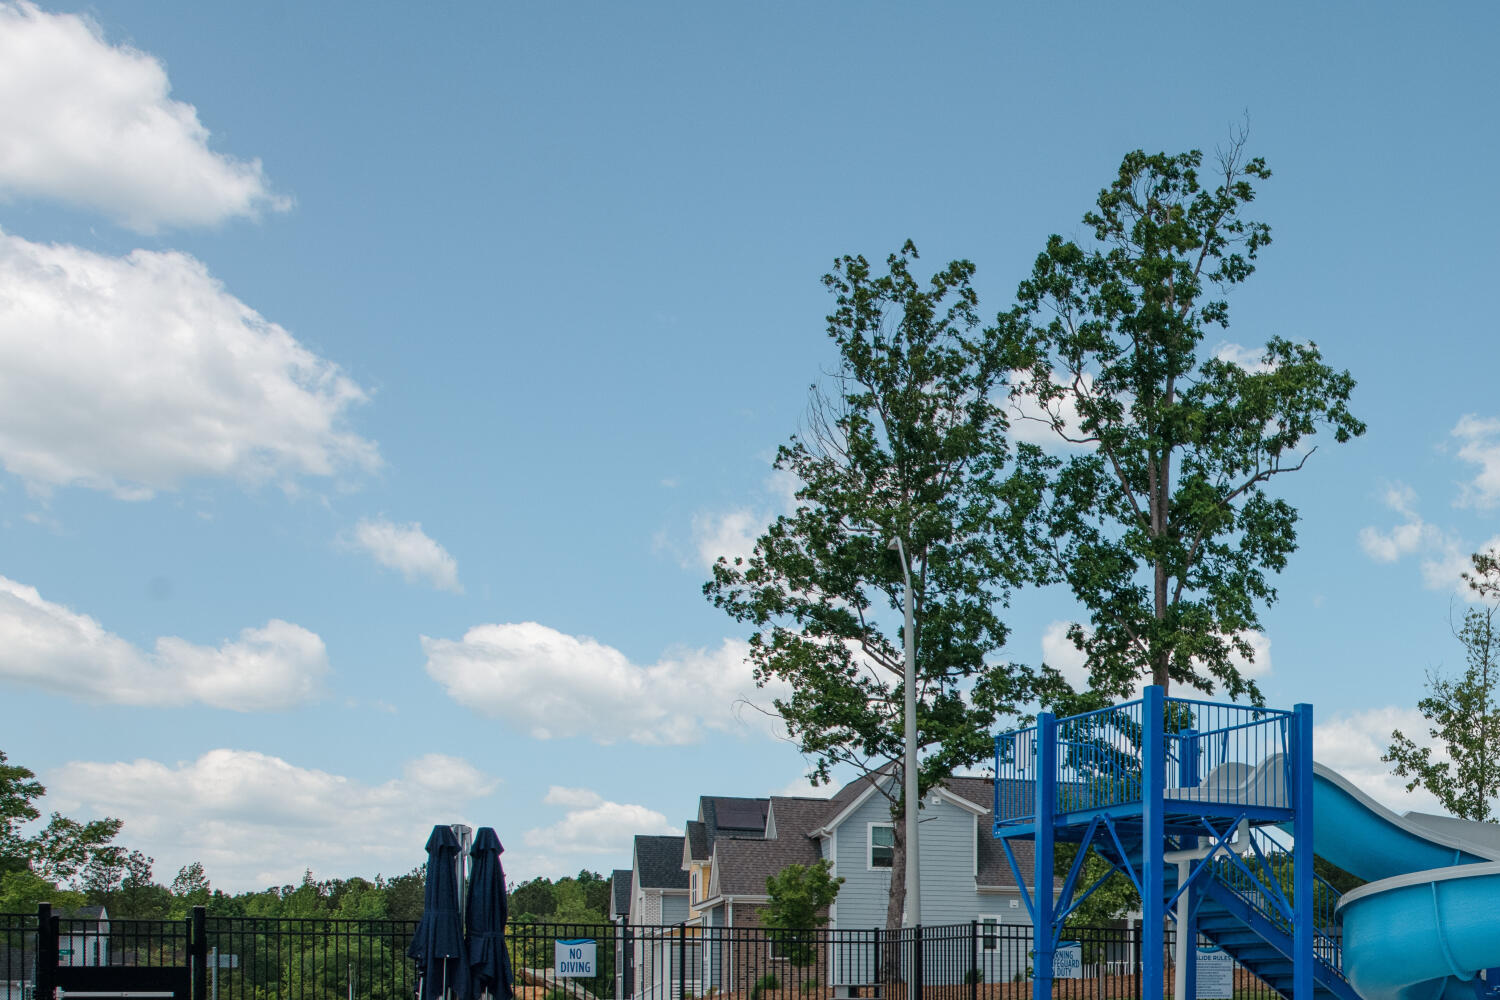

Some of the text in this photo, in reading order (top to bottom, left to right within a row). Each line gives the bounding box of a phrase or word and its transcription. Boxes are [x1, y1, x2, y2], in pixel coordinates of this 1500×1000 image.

[569, 948, 582, 959] NO
[1055, 950, 1073, 959] RNING
[560, 961, 591, 973] DIVING
[1053, 959, 1080, 968] FEGUARD
[1056, 967, 1072, 976] DUTY
